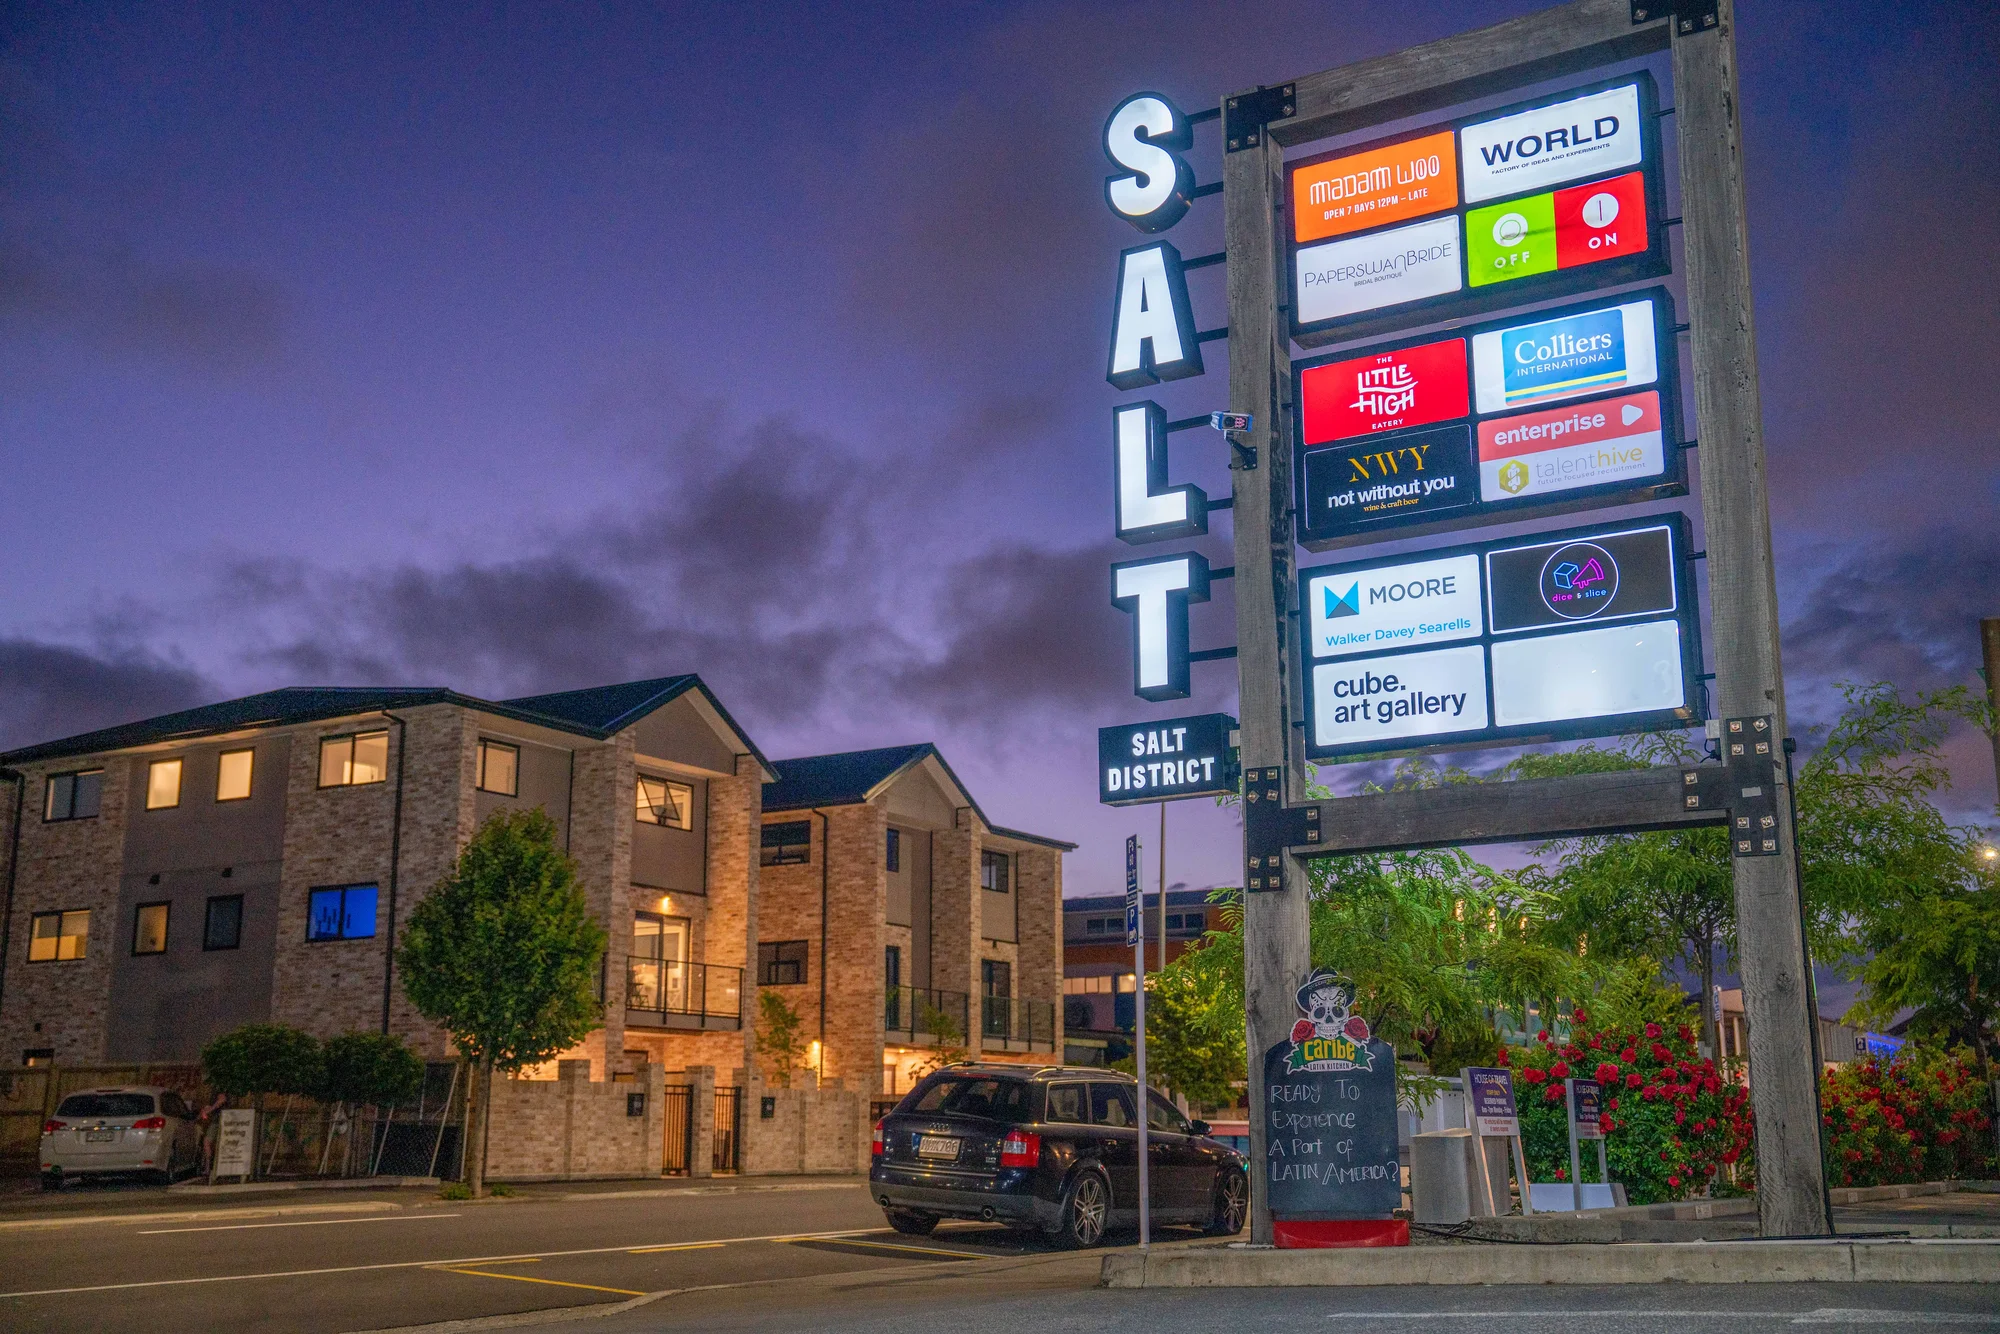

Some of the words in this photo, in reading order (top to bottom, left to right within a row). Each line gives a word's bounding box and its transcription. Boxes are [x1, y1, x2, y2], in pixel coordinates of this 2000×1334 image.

[1480, 115, 1620, 167] WORLD
[1491, 165, 1520, 175] FACTORY
[1531, 157, 1550, 166] IDEAS
[1566, 142, 1610, 158] EXPERIMENTS
[1324, 207, 1345, 220] OPEN
[1347, 206, 1352, 215] 7
[1354, 200, 1375, 214] DAYS
[1378, 195, 1399, 208] 12PM
[1408, 188, 1428, 201] LATE
[1588, 232, 1617, 249] ON
[1494, 250, 1530, 269] OFF
[1354, 278, 1374, 287] BRIDAL
[1374, 271, 1402, 283] BOUTIQUE
[1376, 355, 1393, 365] THE
[1514, 331, 1612, 364] Colliers
[1357, 364, 1415, 393] LITTLE
[1516, 351, 1613, 377] INTERNATIONAL
[1108, 97, 1189, 689] SALT
[1349, 388, 1415, 415] HIGH
[1371, 418, 1404, 430] EATERY
[1494, 413, 1606, 446] enterprise
[1348, 444, 1430, 483] NWY
[1536, 447, 1643, 478] talenthive
[1537, 476, 1562, 486] future
[1564, 471, 1595, 481] focused
[1597, 462, 1647, 476] recruitment
[1328, 490, 1355, 508] not
[1357, 479, 1420, 503] without
[1423, 475, 1455, 496] you
[1363, 503, 1380, 512] wine
[1380, 501, 1387, 509] &
[1387, 499, 1403, 509] craft
[1403, 497, 1419, 506] beer
[1369, 575, 1457, 605] MOORE
[1552, 593, 1573, 602] dice
[1585, 589, 1607, 598] slice
[1326, 632, 1372, 647] Walker
[1375, 626, 1416, 641] Davey
[1418, 617, 1471, 635] Searells
[1333, 671, 1406, 698] cube.
[1334, 699, 1371, 724] art
[1376, 691, 1467, 724] gallery
[1132, 727, 1187, 757] SALT
[1108, 756, 1215, 792] DISTRICT
[1309, 1063, 1326, 1071] LATIN
[1326, 1062, 1350, 1070] KITCHEN
[1268, 1138, 1286, 1157] A
[1292, 1138, 1323, 1156] Part
